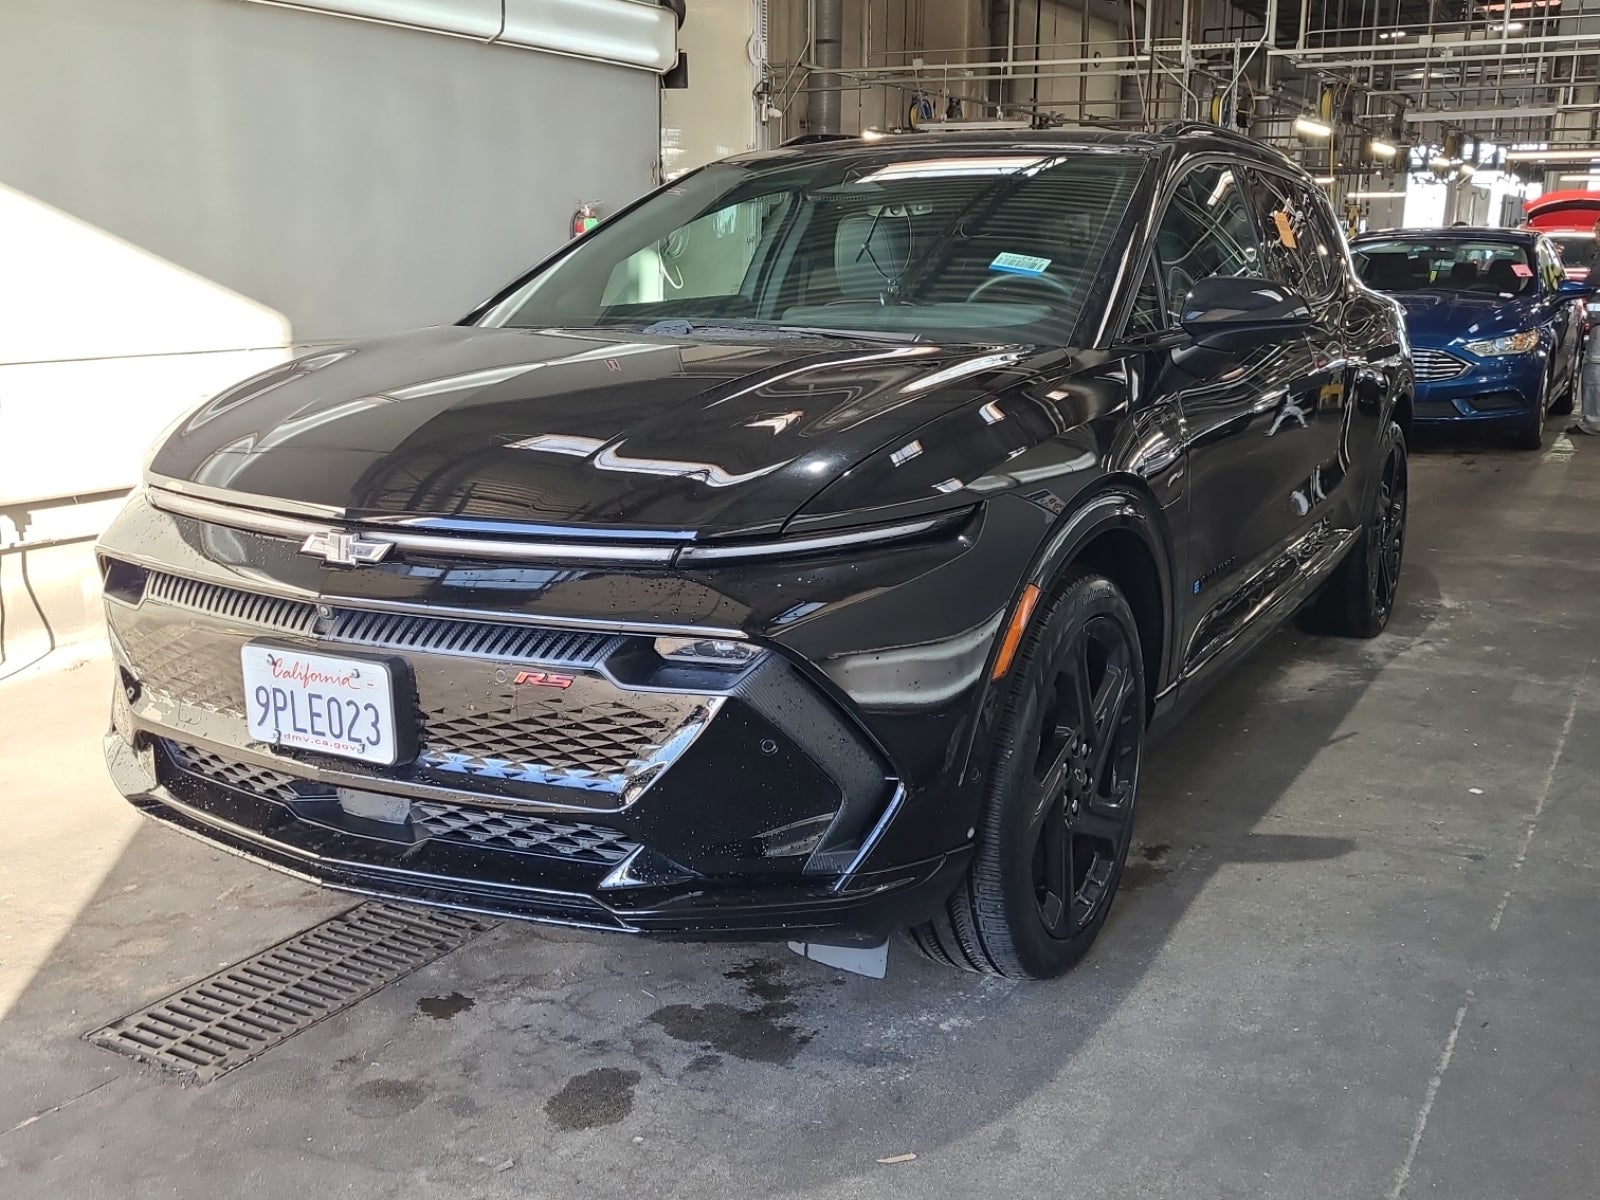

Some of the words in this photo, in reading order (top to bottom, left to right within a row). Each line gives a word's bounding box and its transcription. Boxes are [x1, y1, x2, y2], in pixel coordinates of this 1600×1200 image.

[272, 657, 361, 690] California
[513, 670, 576, 689] RS
[255, 684, 382, 747] 9PLE023
[283, 732, 356, 751] dmv.ca.gov
